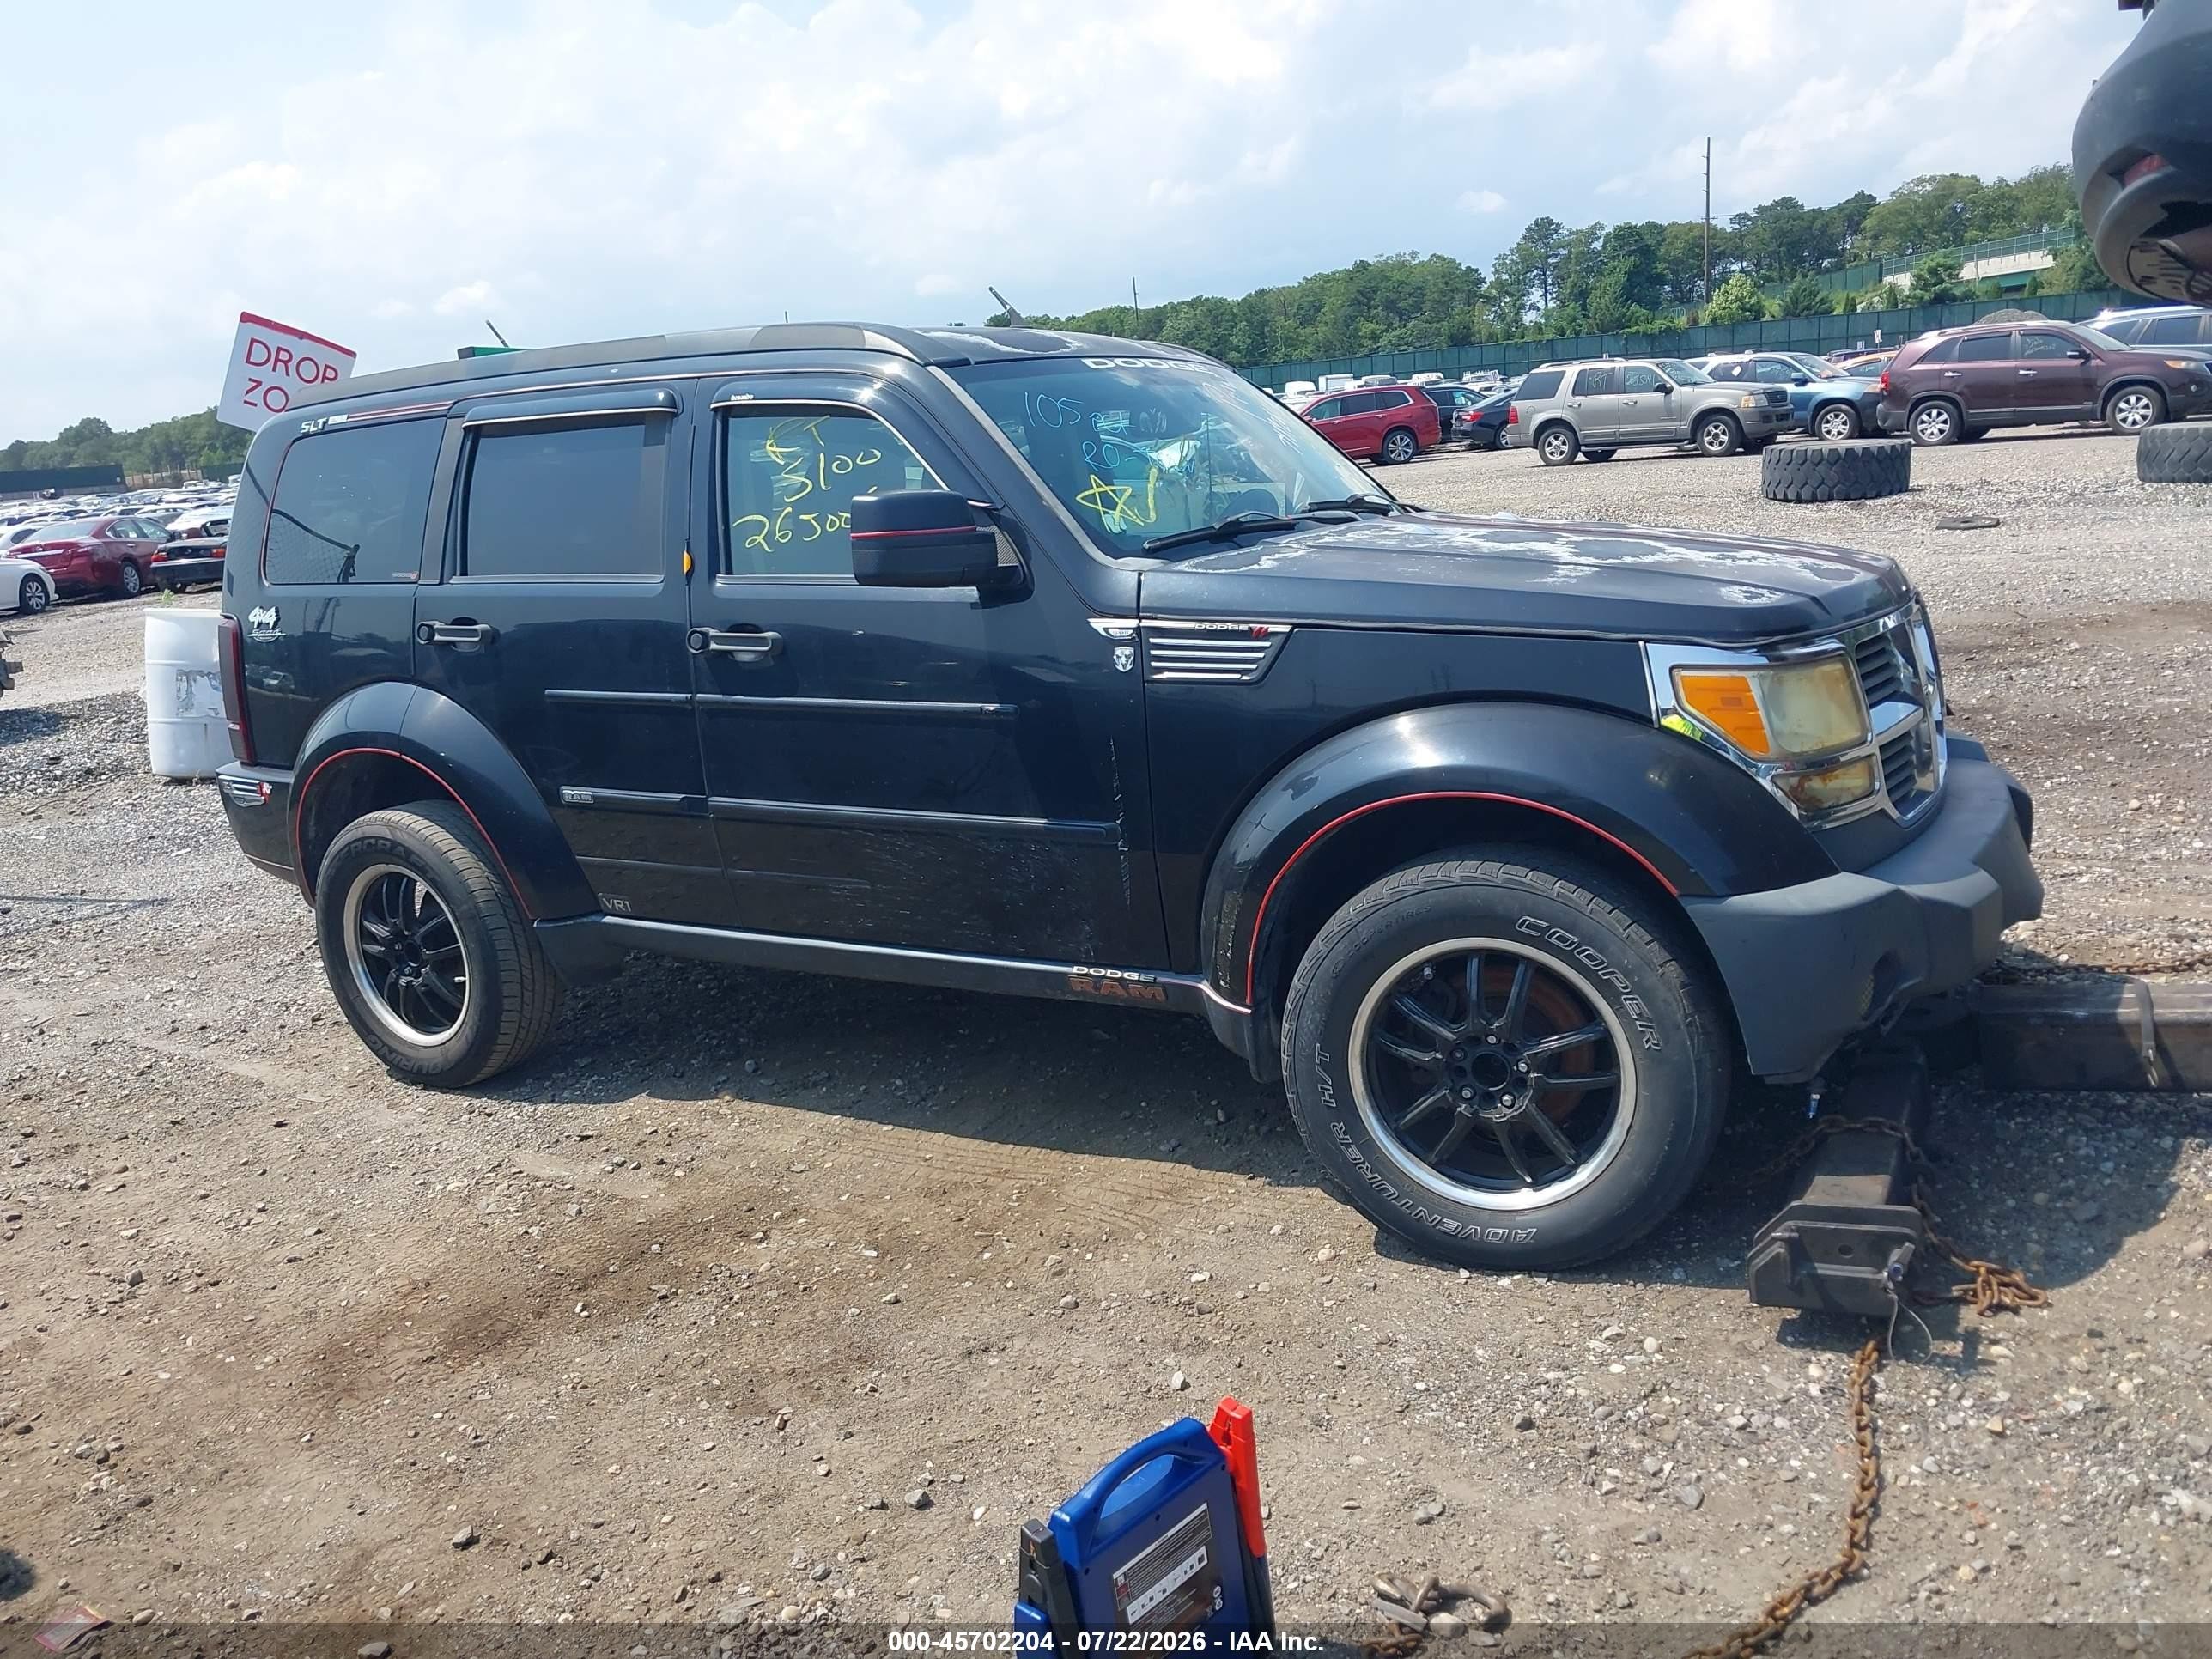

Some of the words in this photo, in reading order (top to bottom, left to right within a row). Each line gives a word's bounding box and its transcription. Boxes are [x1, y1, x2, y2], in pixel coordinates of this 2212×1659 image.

[246, 337, 338, 384] DROP
[1081, 357, 1214, 374] DODGE
[243, 378, 289, 413] ZO
[301, 417, 327, 434] SLT
[562, 790, 593, 802] RAM
[602, 897, 632, 912] VR1
[1073, 966, 1155, 982] DODGE
[1516, 915, 1663, 1050] COOPER
[1068, 975, 1166, 1002] RAM
[1316, 1043, 1337, 1107] H/T
[1330, 1121, 1538, 1244] ADVENTURER
